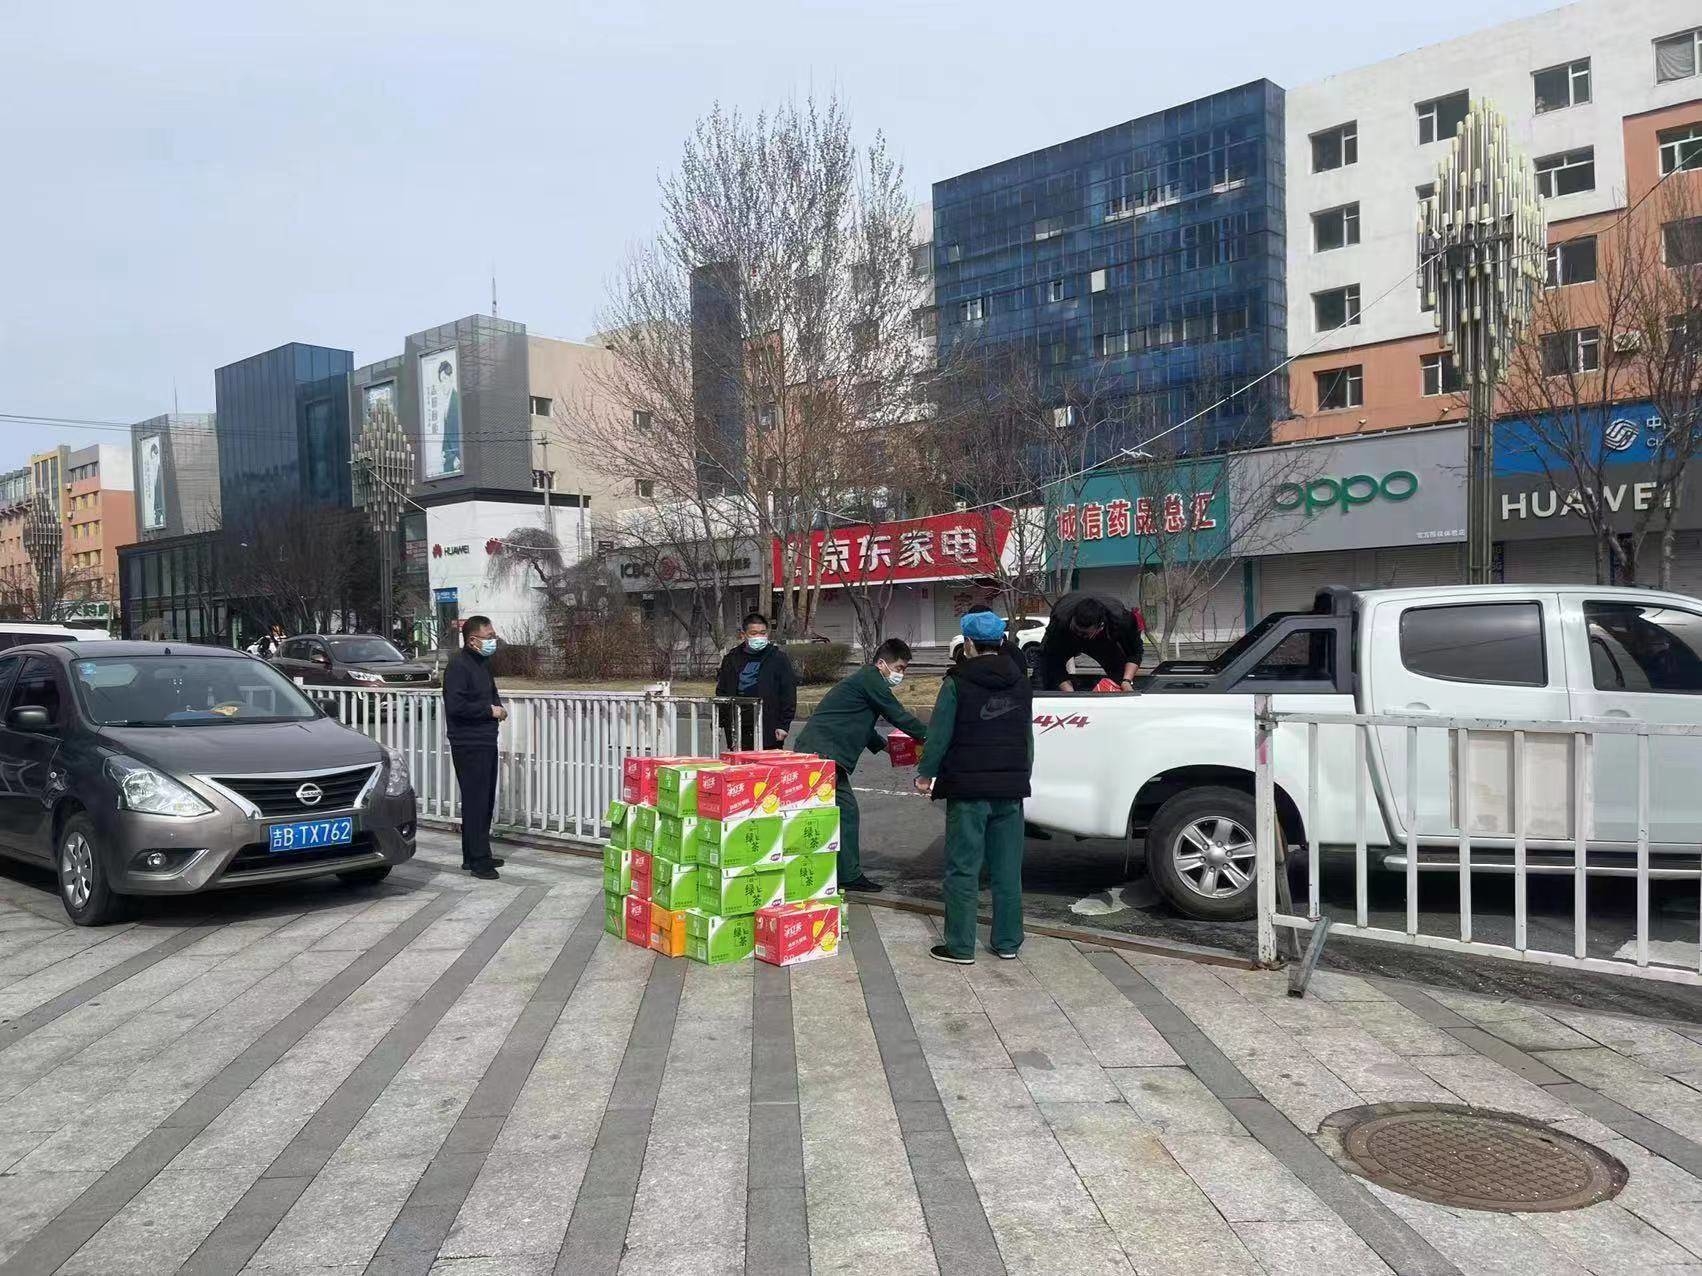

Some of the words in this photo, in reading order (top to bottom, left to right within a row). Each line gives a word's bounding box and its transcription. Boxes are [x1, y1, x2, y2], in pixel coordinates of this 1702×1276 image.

[444, 544, 470, 556] HUAWEI
[817, 525, 979, 576] 京东家电
